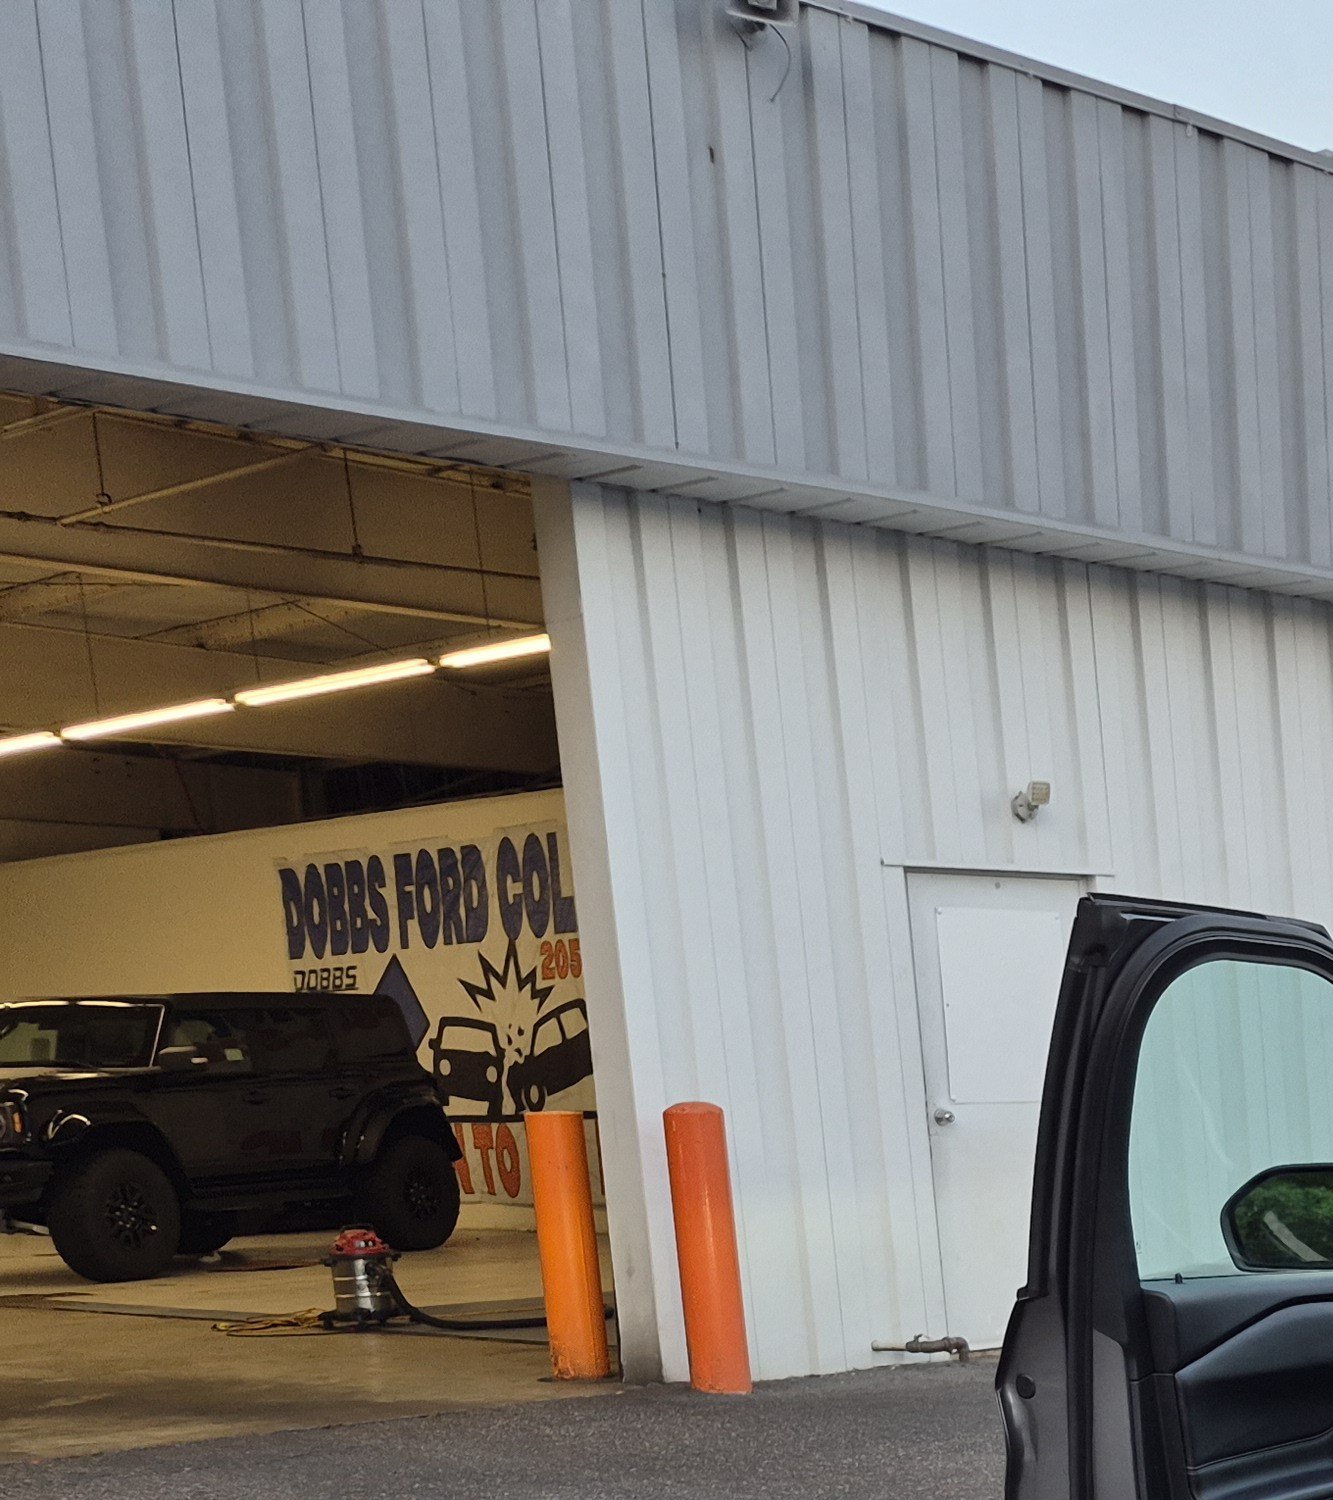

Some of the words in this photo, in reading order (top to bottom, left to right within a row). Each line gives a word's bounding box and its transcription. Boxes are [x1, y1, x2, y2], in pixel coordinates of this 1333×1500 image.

[278, 854, 391, 960] DOBBS
[393, 843, 489, 949] FORD
[293, 965, 358, 992] DOBBS
[471, 1122, 521, 1198] TO
